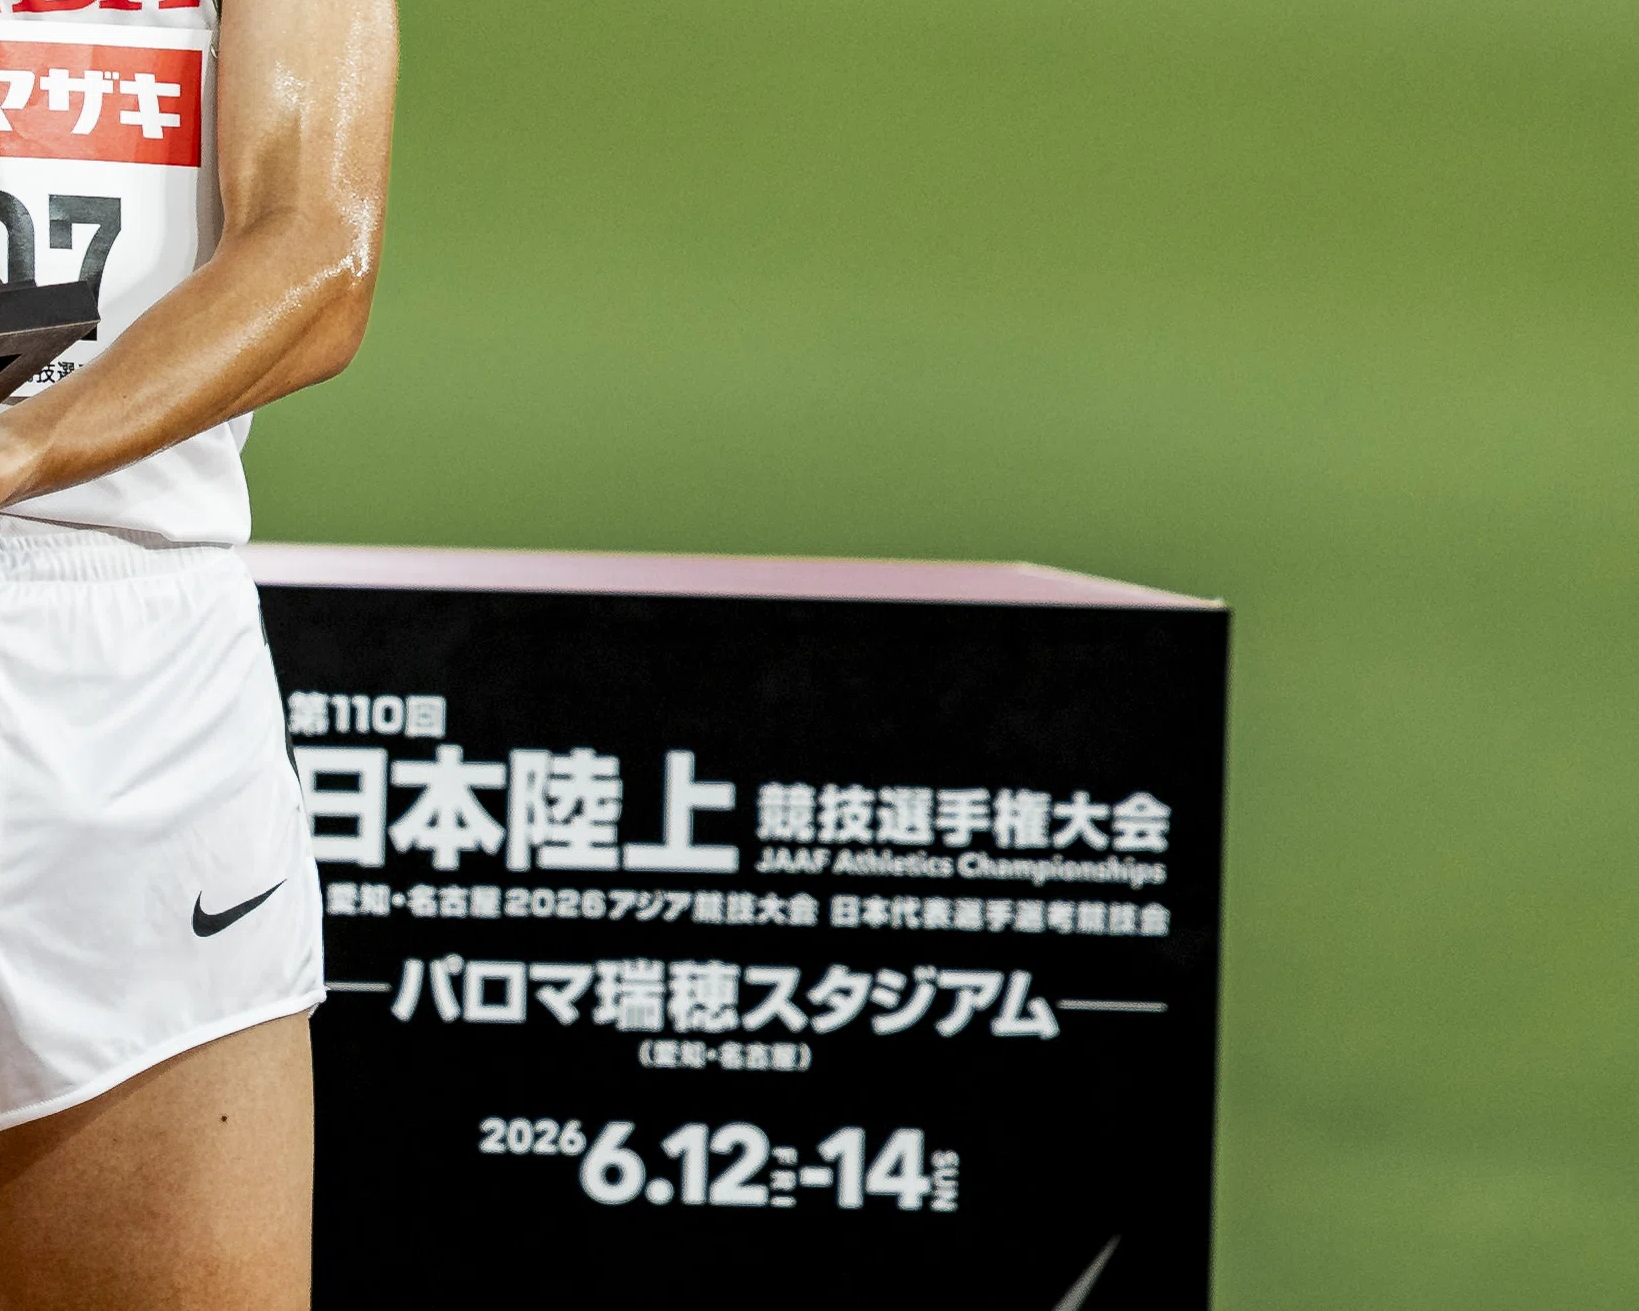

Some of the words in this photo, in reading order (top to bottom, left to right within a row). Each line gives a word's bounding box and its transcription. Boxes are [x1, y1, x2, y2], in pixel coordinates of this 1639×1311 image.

[288, 692, 447, 737] 第110回
[294, 744, 740, 874] 日本陸上
[757, 782, 1171, 852] 競技選手権大会
[755, 847, 831, 875] JAAF
[832, 848, 955, 878] Athletics
[956, 851, 1168, 889] Championships
[391, 954, 1060, 1039] パロマ瑞穂スタジアム
[478, 1116, 587, 1156] 2026
